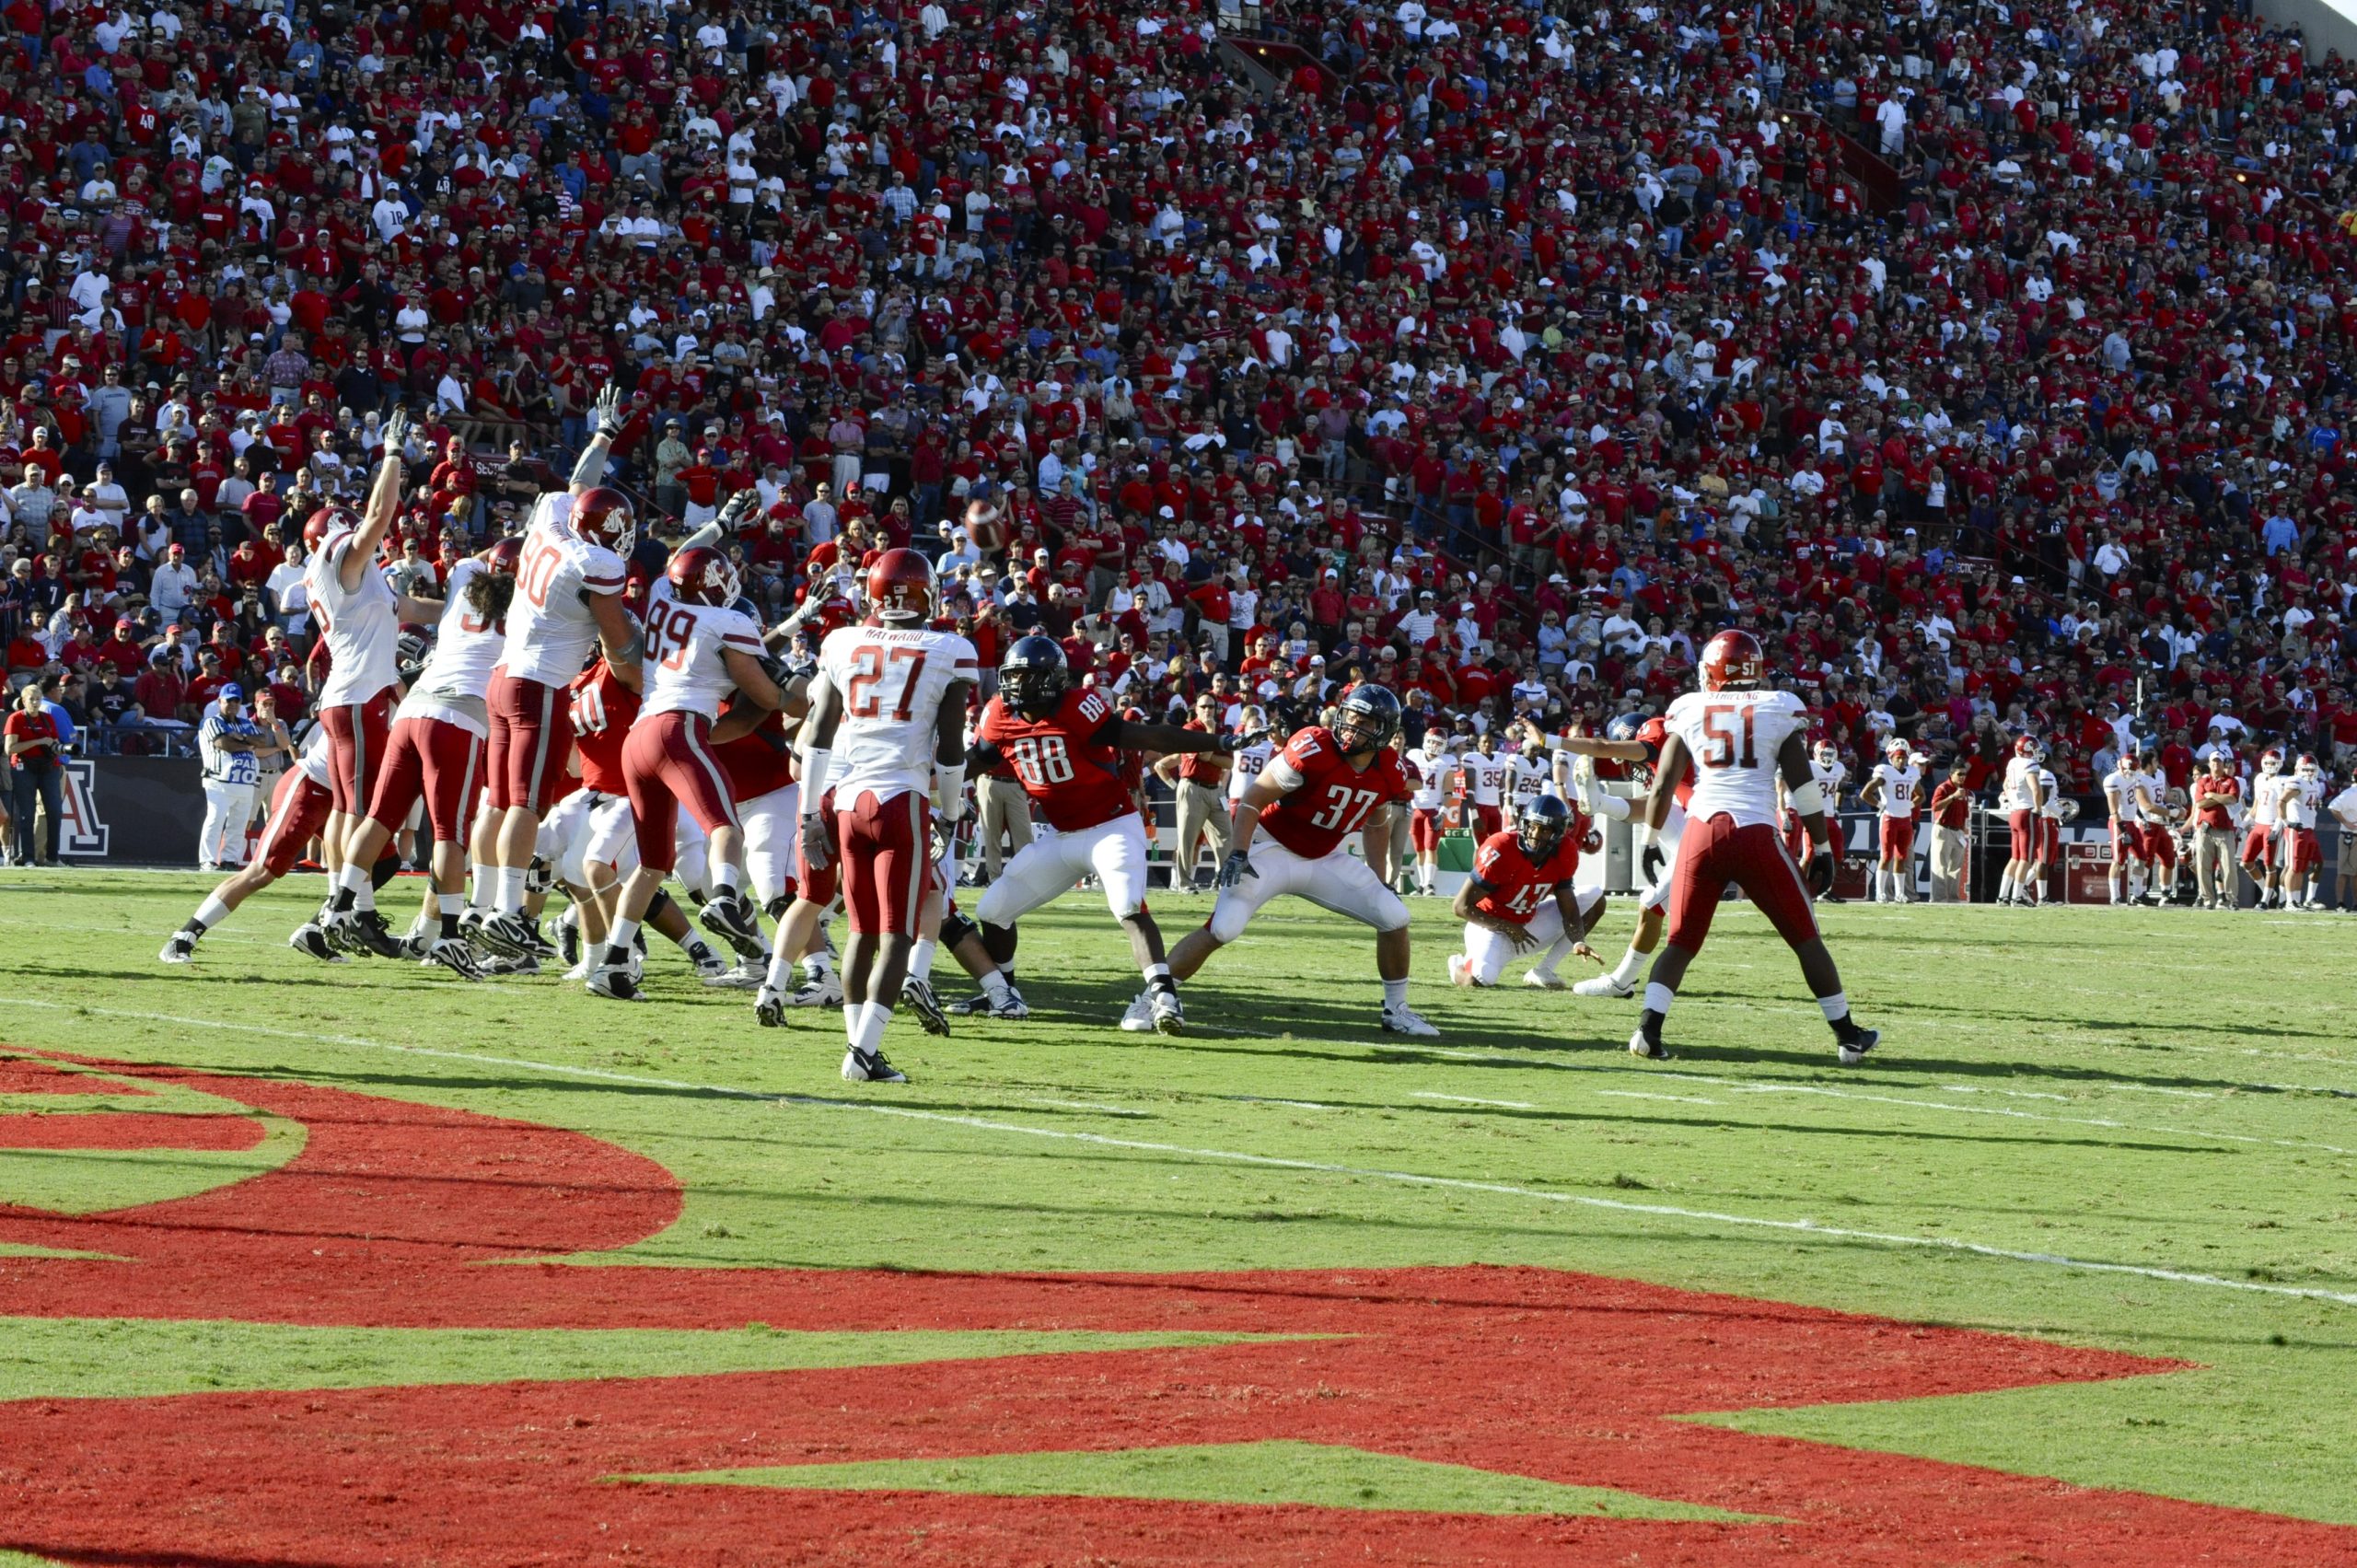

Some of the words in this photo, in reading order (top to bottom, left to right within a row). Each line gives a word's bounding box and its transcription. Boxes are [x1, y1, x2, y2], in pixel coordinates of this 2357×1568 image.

[140, 114, 155, 130] 48
[390, 211, 403, 226] 18
[322, 257, 330, 273] 7
[517, 530, 562, 608] 90
[49, 586, 57, 605] 7
[883, 595, 904, 610] 27
[644, 598, 697, 671] 89
[1742, 662, 1755, 676] 51
[849, 645, 928, 722] 27
[1078, 693, 1105, 723] 88
[1291, 733, 1322, 760] 37
[1703, 704, 1758, 769] 51
[1014, 736, 1074, 785] 88
[1238, 754, 1264, 775] 69
[1395, 760, 1408, 782] 3
[231, 768, 256, 784] 10
[1818, 782, 1835, 798] 34
[1896, 784, 1910, 801] 81
[2128, 789, 2137, 806] 2
[2155, 787, 2165, 804] 6
[1311, 784, 1379, 834] 37
[1480, 845, 1501, 867] 47
[1505, 883, 1553, 914] 47
